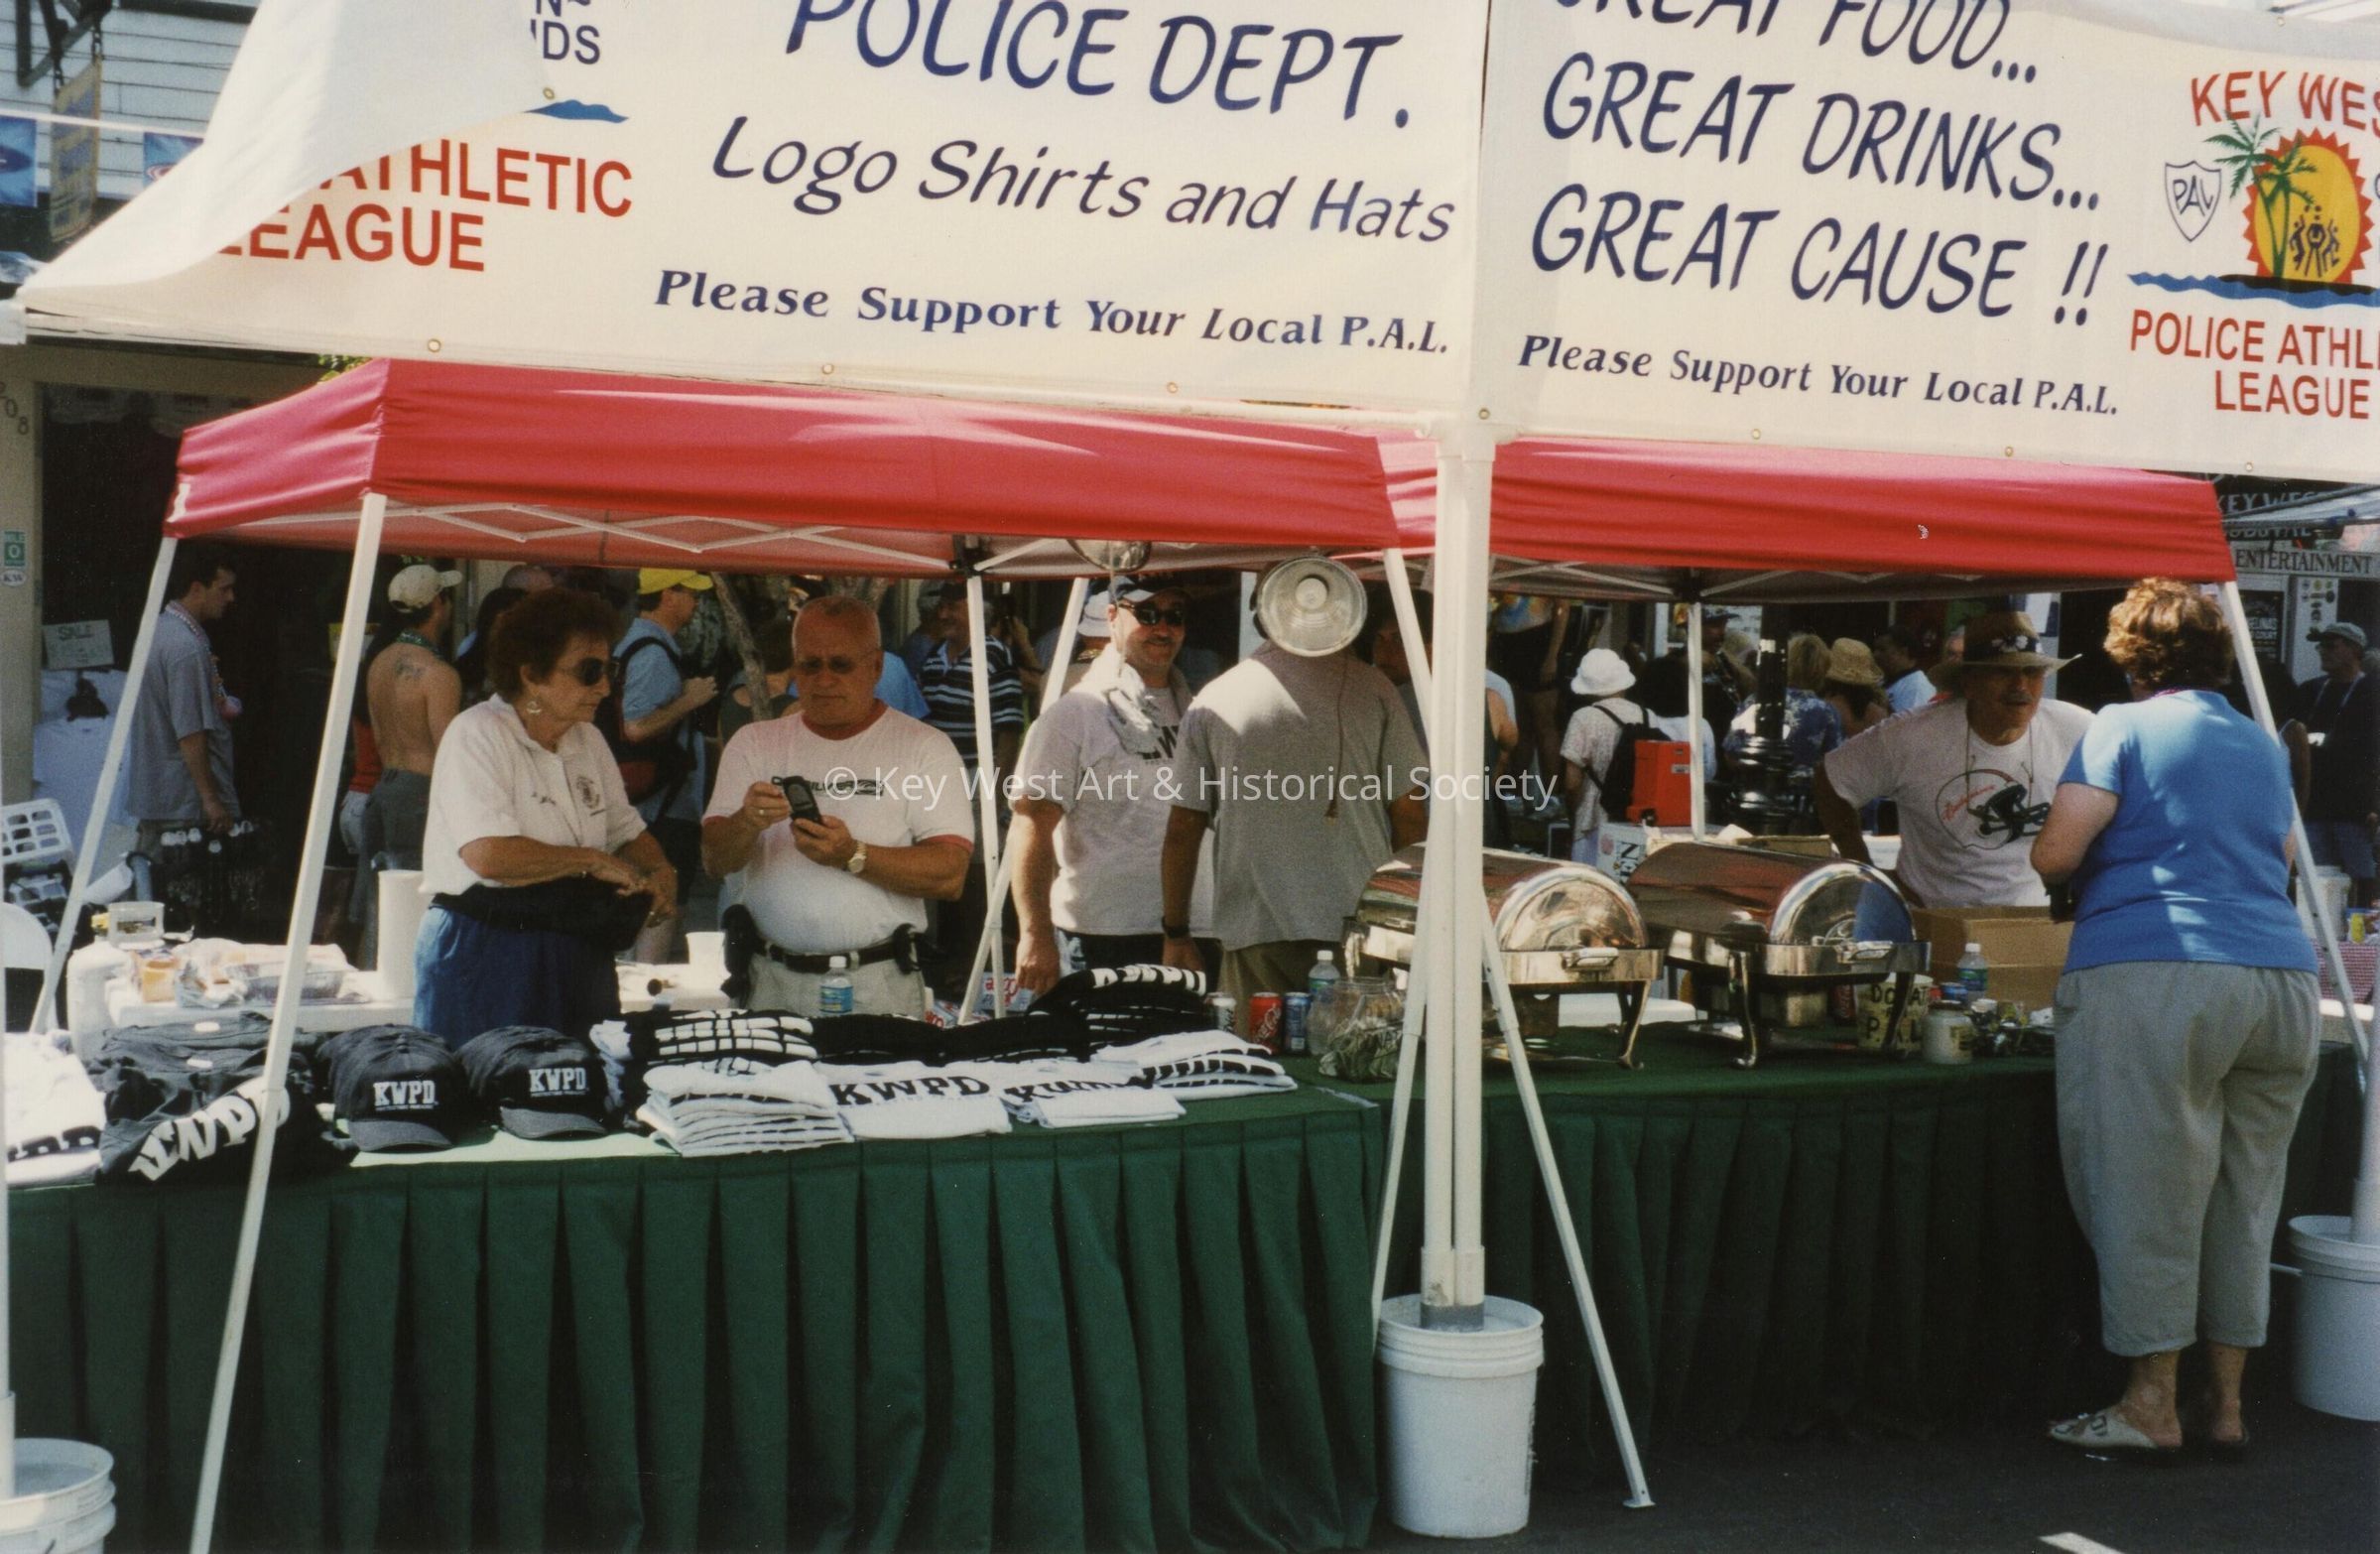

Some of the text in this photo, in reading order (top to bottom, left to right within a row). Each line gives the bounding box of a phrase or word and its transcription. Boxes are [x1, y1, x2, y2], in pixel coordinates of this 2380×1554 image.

[784, 0, 1410, 129] POLICE DEPT.
[1542, 52, 2100, 211] GREAT DRINKS...
[2190, 69, 2380, 138] KEY WE
[712, 115, 1455, 242] Logo Shirts and Hats
[2172, 174, 2215, 217] PAL
[218, 201, 486, 274] EAGUE
[1531, 183, 1782, 291] GREAT
[1791, 217, 2029, 318] CAUSE
[655, 269, 1450, 354] Please Support Your Local P.A.L.
[2129, 308, 2380, 372] POLICE ATHL
[1518, 334, 2119, 415] Please Support Your Local P.A.L.
[2214, 369, 2371, 420] LEAGUE
[2235, 548, 2373, 574] ENTERTAINMENT
[372, 1080, 437, 1105] KWPD
[528, 1067, 587, 1093] KWPD
[828, 1075, 992, 1106] KWPD
